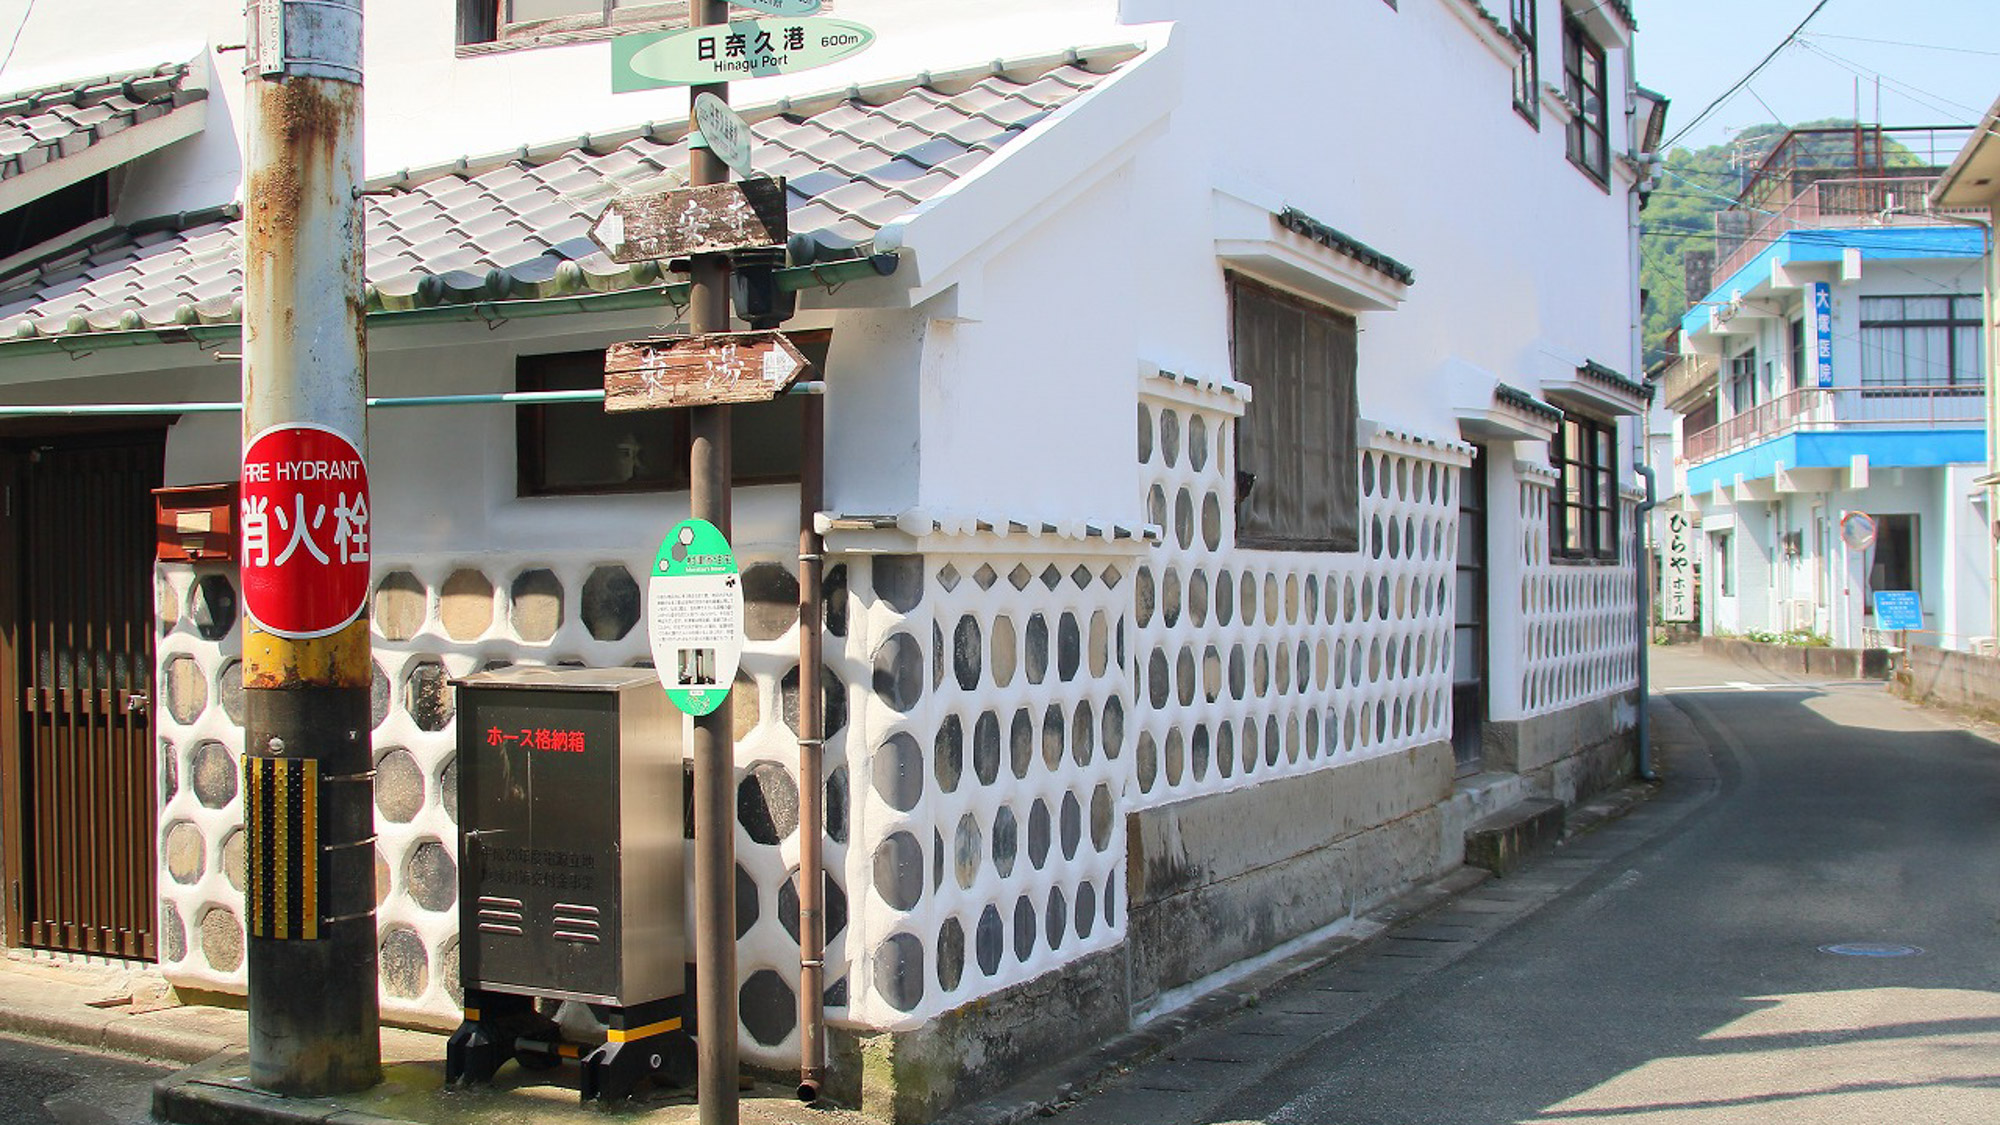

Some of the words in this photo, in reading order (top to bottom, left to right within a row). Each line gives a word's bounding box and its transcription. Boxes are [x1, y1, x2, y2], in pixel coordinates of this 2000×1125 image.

[698, 27, 804, 61] 日奈久港
[821, 35, 859, 48] 600m
[713, 58, 757, 73] Hinagu
[761, 54, 788, 68] Port
[276, 460, 360, 481] HYDRANT
[241, 491, 370, 568] 消火栓
[1669, 513, 1688, 616] ひらやホテル
[486, 726, 585, 753] ホース格納箱
